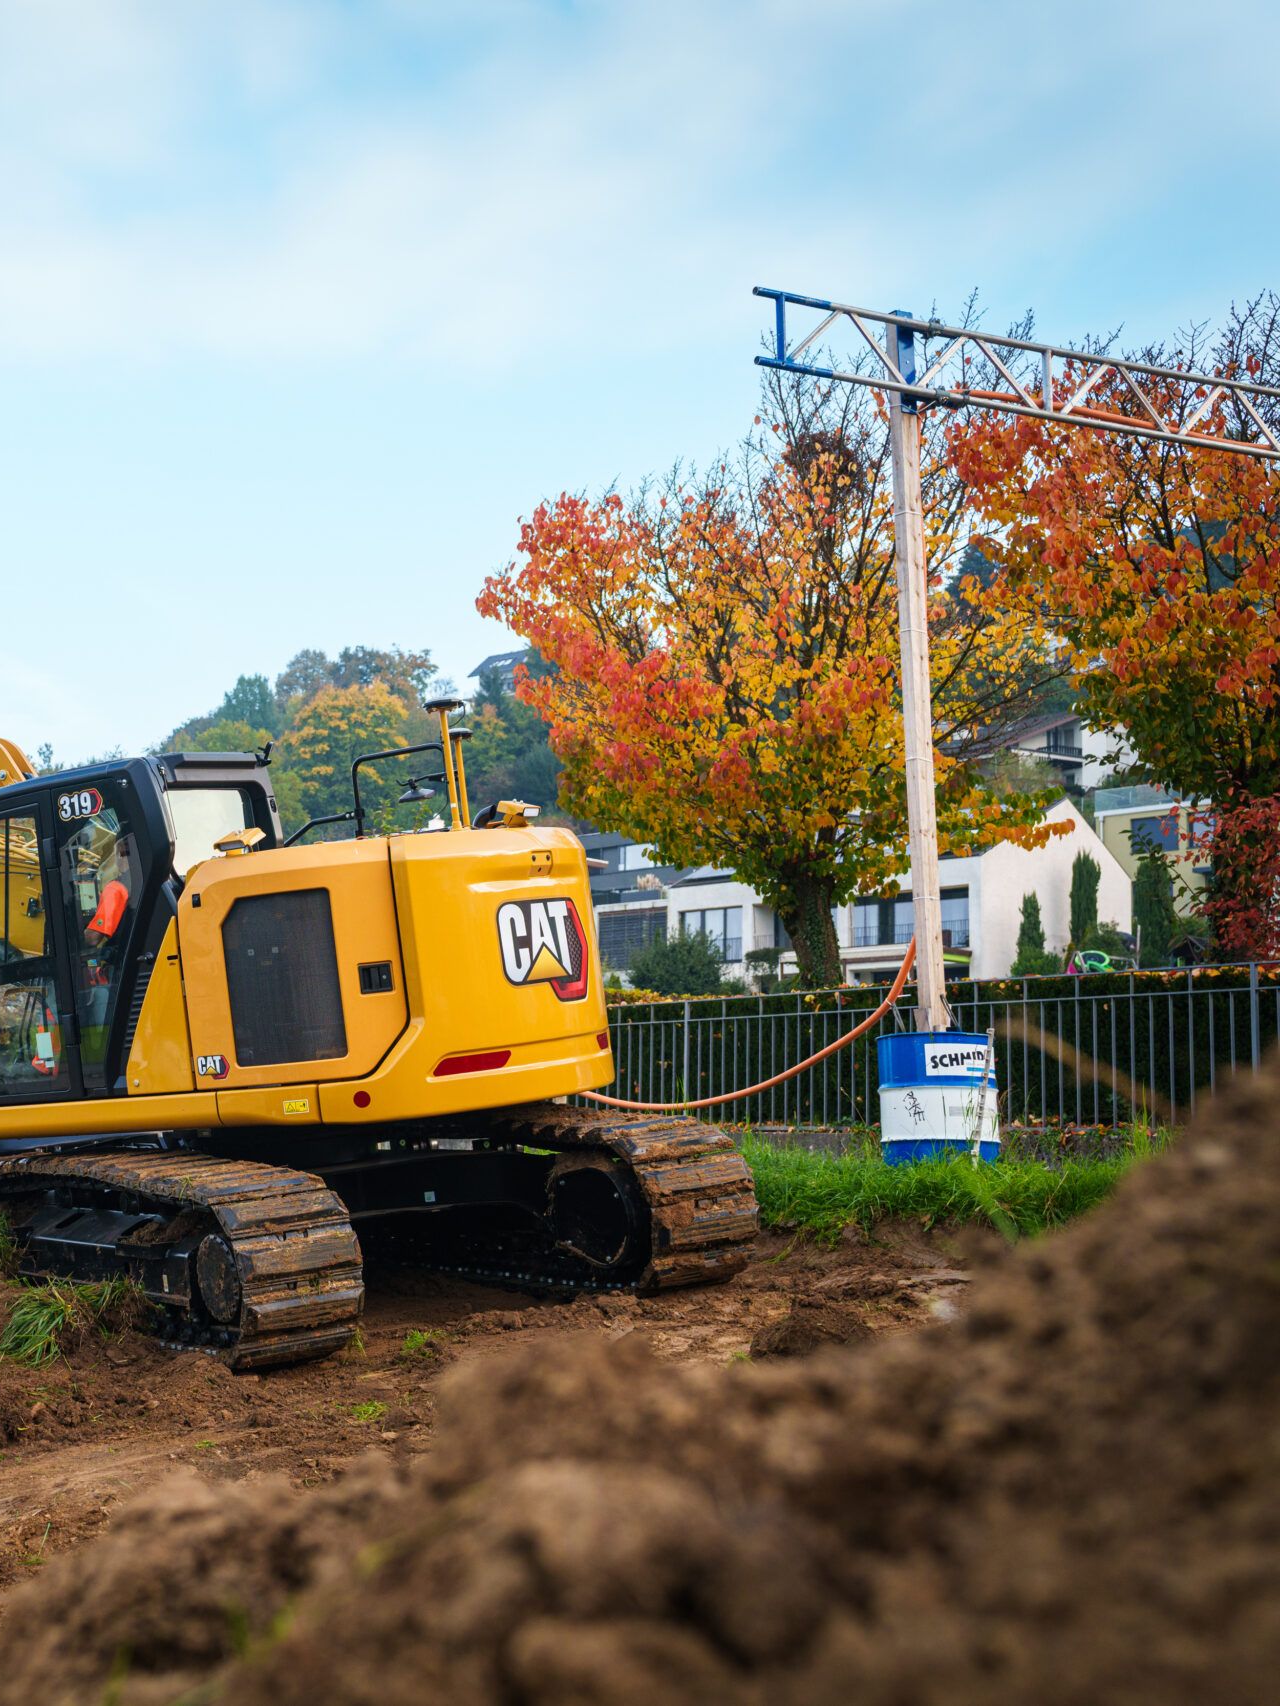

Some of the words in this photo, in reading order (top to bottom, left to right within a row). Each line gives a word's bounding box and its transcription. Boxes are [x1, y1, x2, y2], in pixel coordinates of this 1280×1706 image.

[60, 792, 91, 818] 319
[498, 900, 573, 983] CAT
[198, 1056, 221, 1075] CAT
